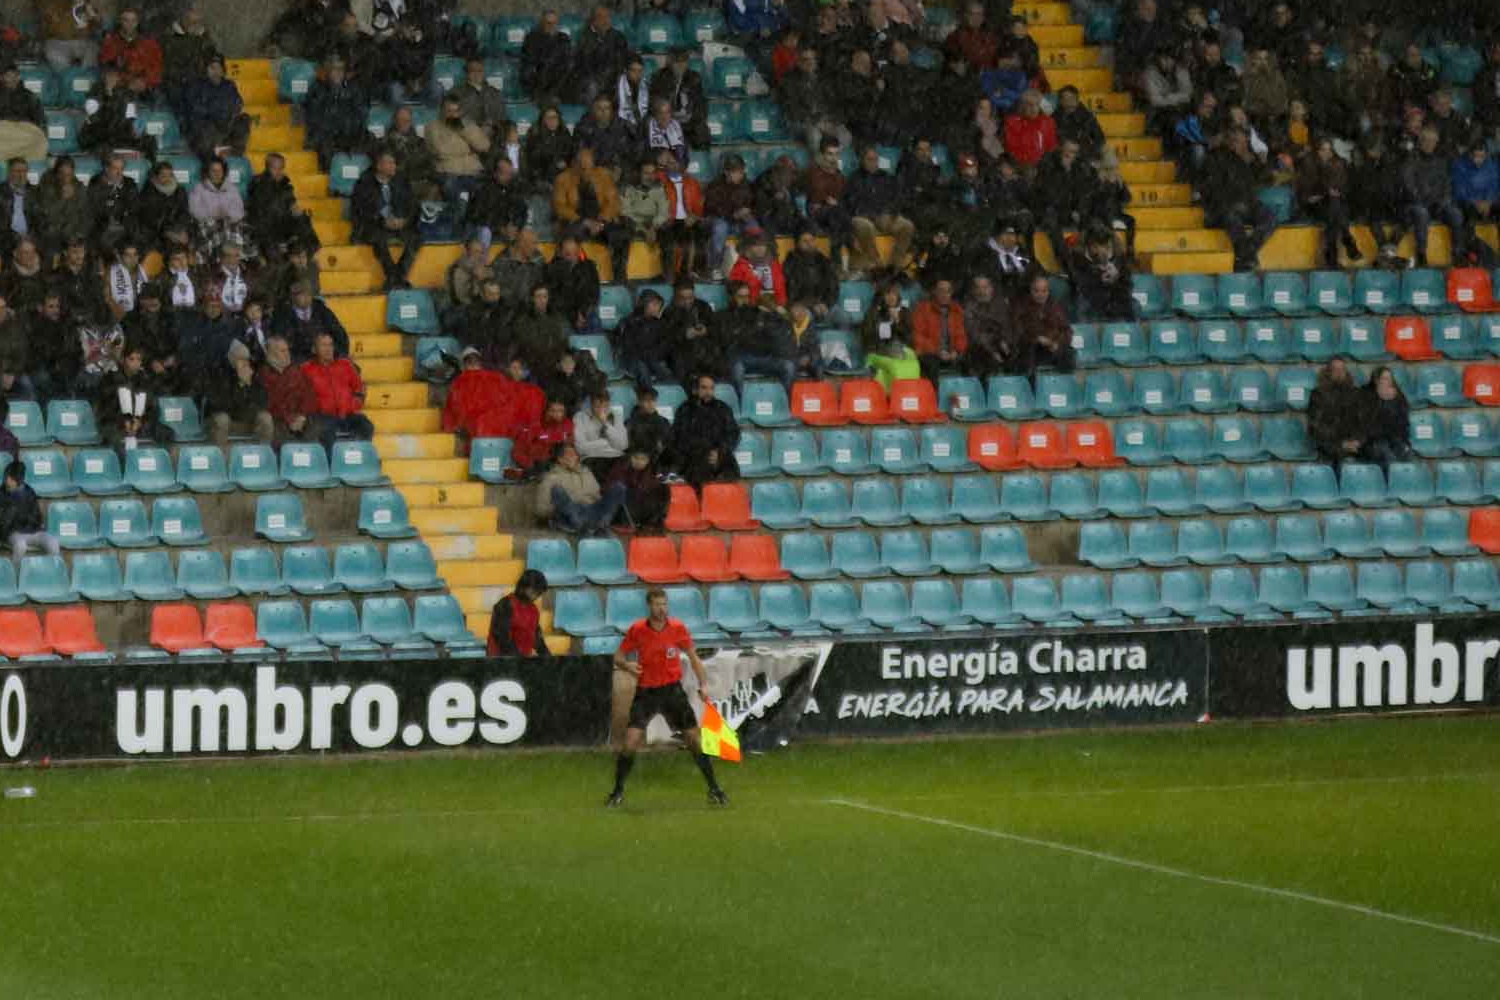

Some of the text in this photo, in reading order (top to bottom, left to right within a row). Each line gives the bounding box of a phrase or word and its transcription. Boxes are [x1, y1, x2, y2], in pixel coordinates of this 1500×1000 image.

[882, 641, 1147, 685] Energía Charra
[116, 666, 527, 754] umbro.es
[838, 678, 1189, 719] ENERGÍA PARA SALAMANCA
